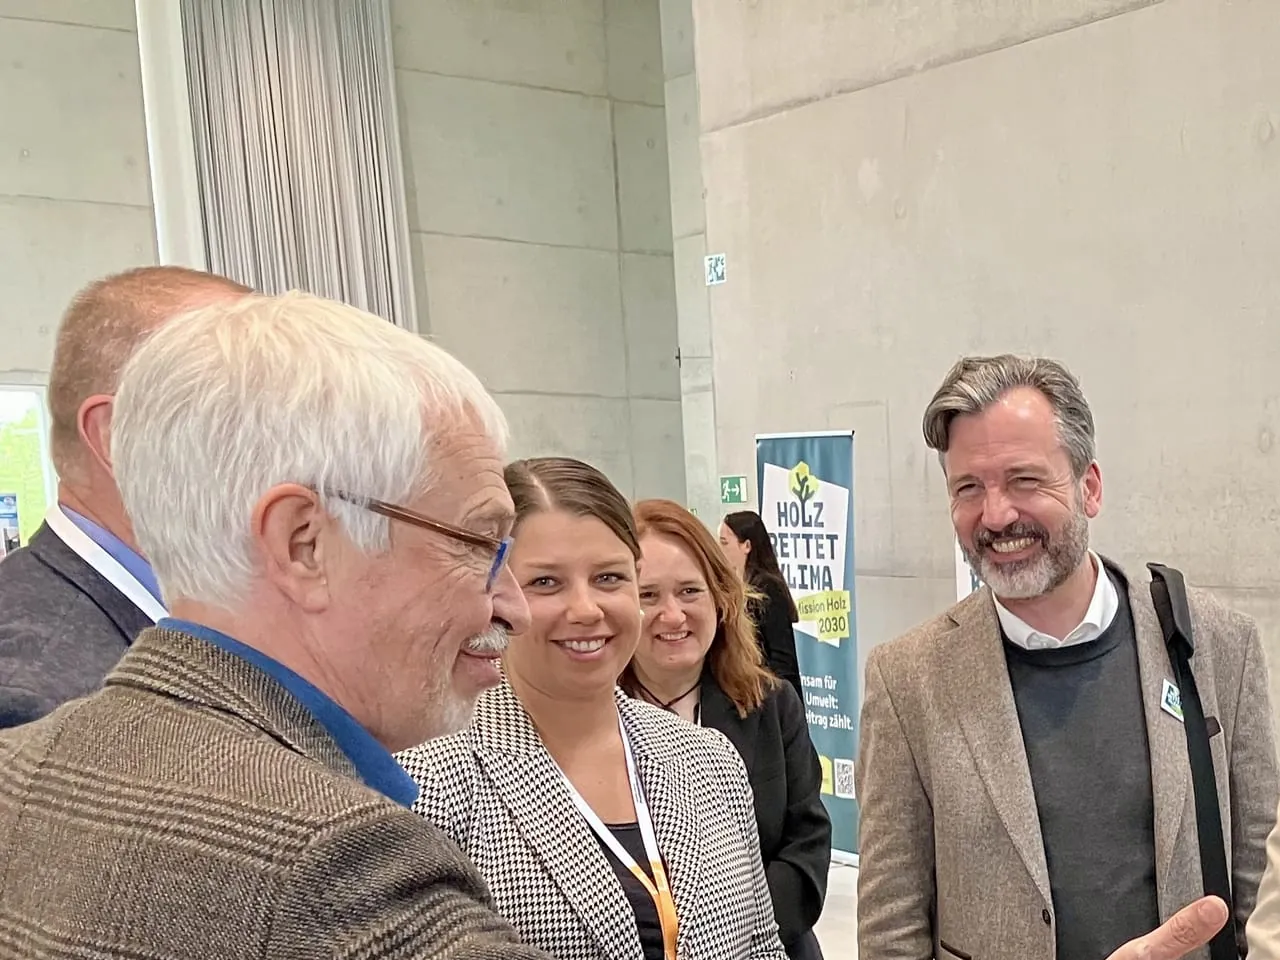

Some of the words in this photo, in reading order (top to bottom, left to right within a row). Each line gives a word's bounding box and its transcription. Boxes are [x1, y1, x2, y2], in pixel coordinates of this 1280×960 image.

[777, 501, 825, 528] HOLZ
[780, 563, 834, 591] LIMA
[826, 596, 847, 612] Holz
[819, 616, 846, 633] 2030
[824, 674, 837, 690] für
[805, 691, 839, 710] Umwelt:
[829, 713, 854, 730] zählt.
